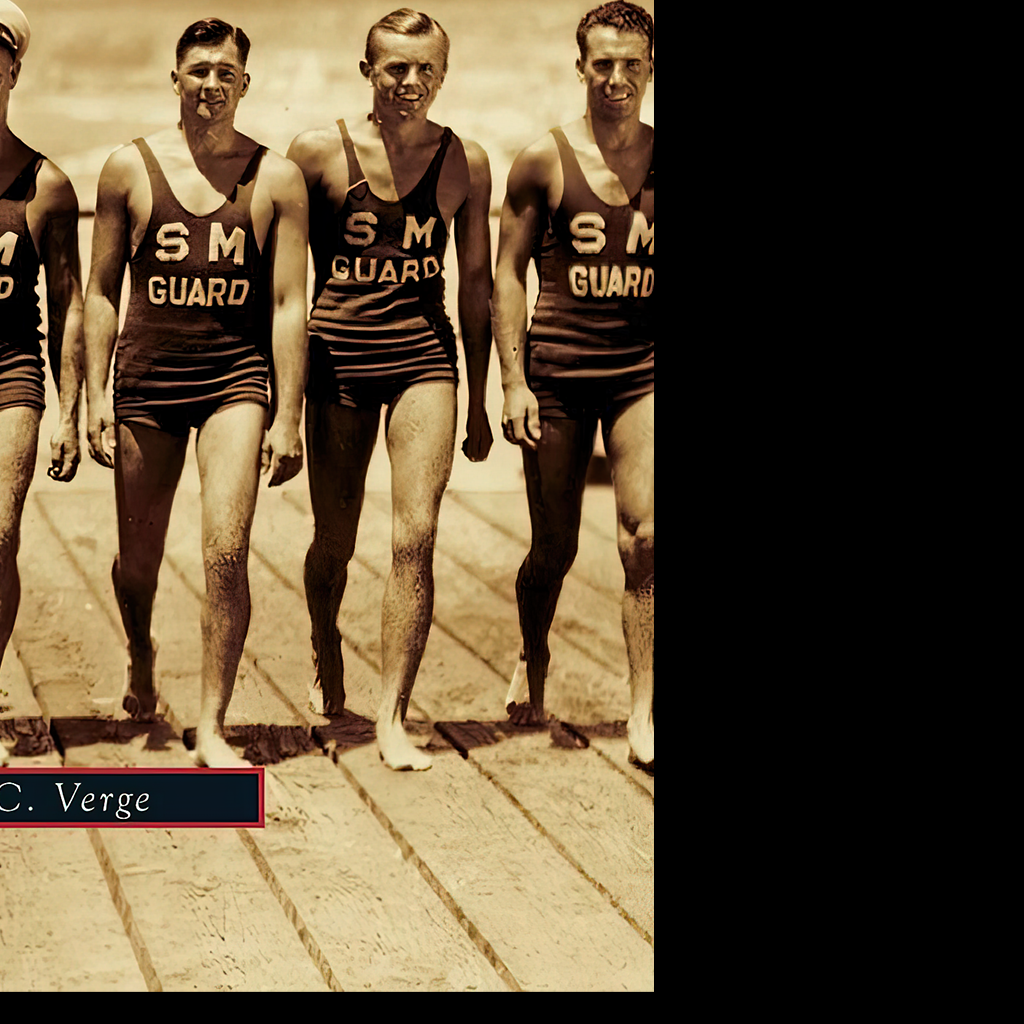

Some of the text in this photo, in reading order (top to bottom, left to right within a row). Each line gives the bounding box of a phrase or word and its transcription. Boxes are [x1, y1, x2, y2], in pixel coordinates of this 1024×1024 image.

[155, 221, 246, 266] S M
[343, 211, 438, 250] S M
[569, 211, 607, 255] S
[331, 254, 441, 284] GUARD
[568, 264, 655, 298] GUARD
[147, 276, 251, 307] GUARD
[53, 781, 151, 820] Verge
